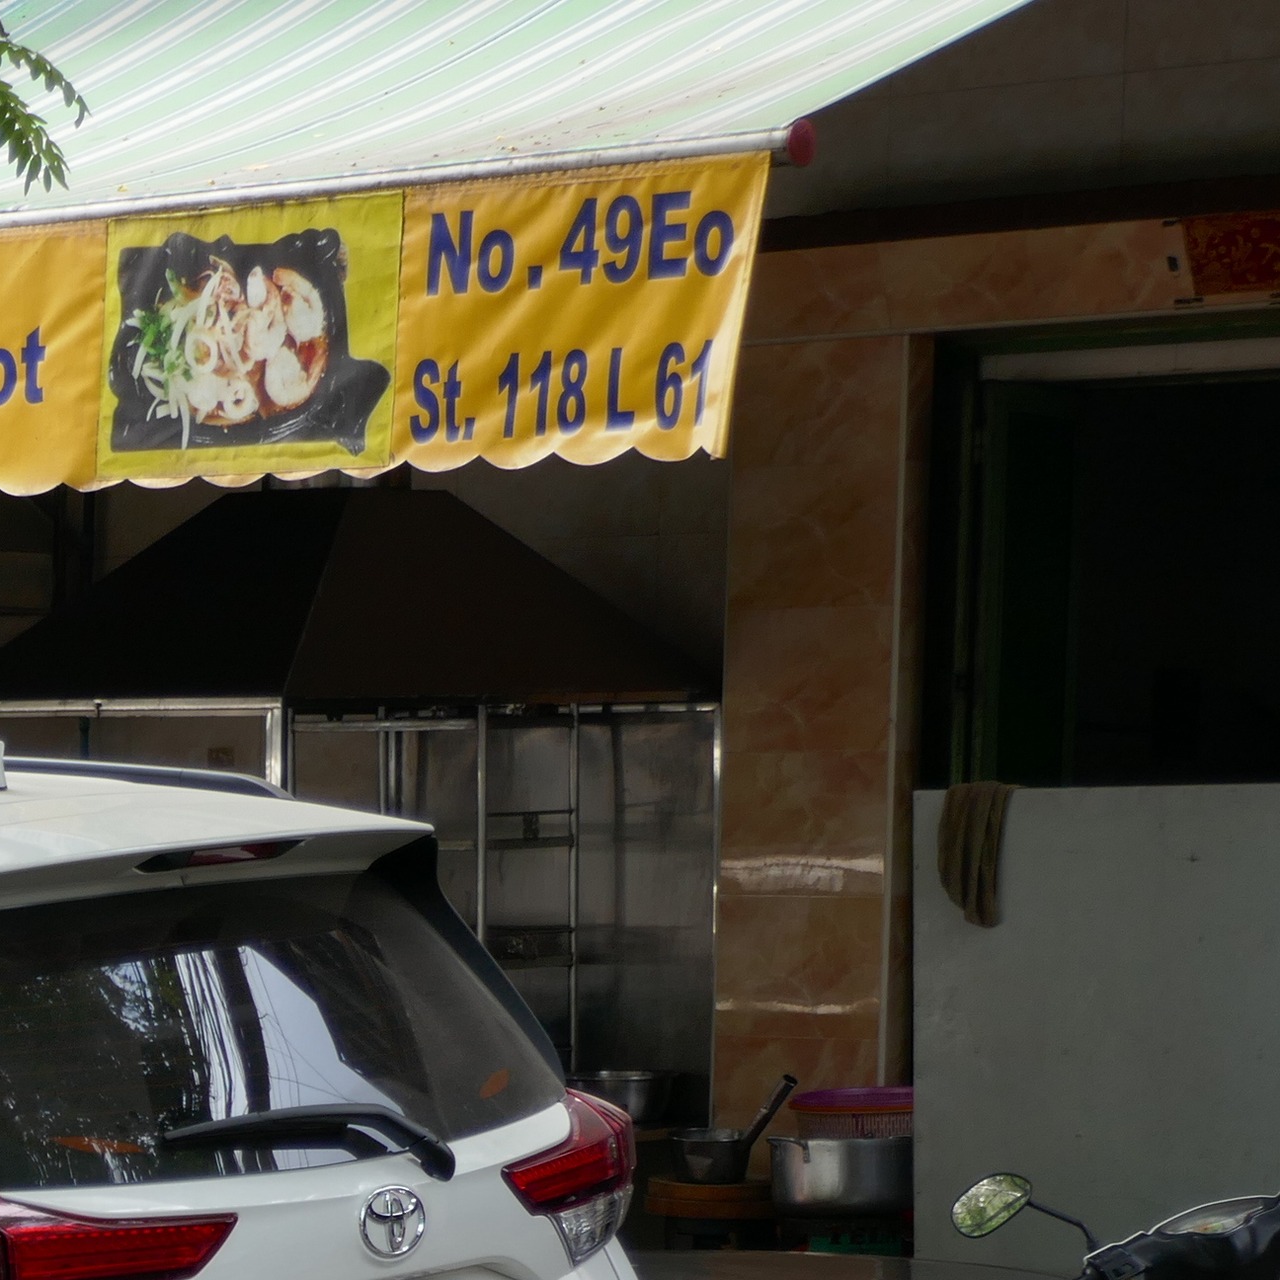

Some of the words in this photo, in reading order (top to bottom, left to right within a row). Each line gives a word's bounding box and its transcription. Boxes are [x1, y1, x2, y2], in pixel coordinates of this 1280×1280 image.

[427, 210, 542, 296] No.
[559, 190, 734, 285] 49Eo
[410, 358, 476, 444] St.
[498, 349, 588, 439] 118
[605, 347, 635, 432] L
[655, 340, 713, 431] 61
